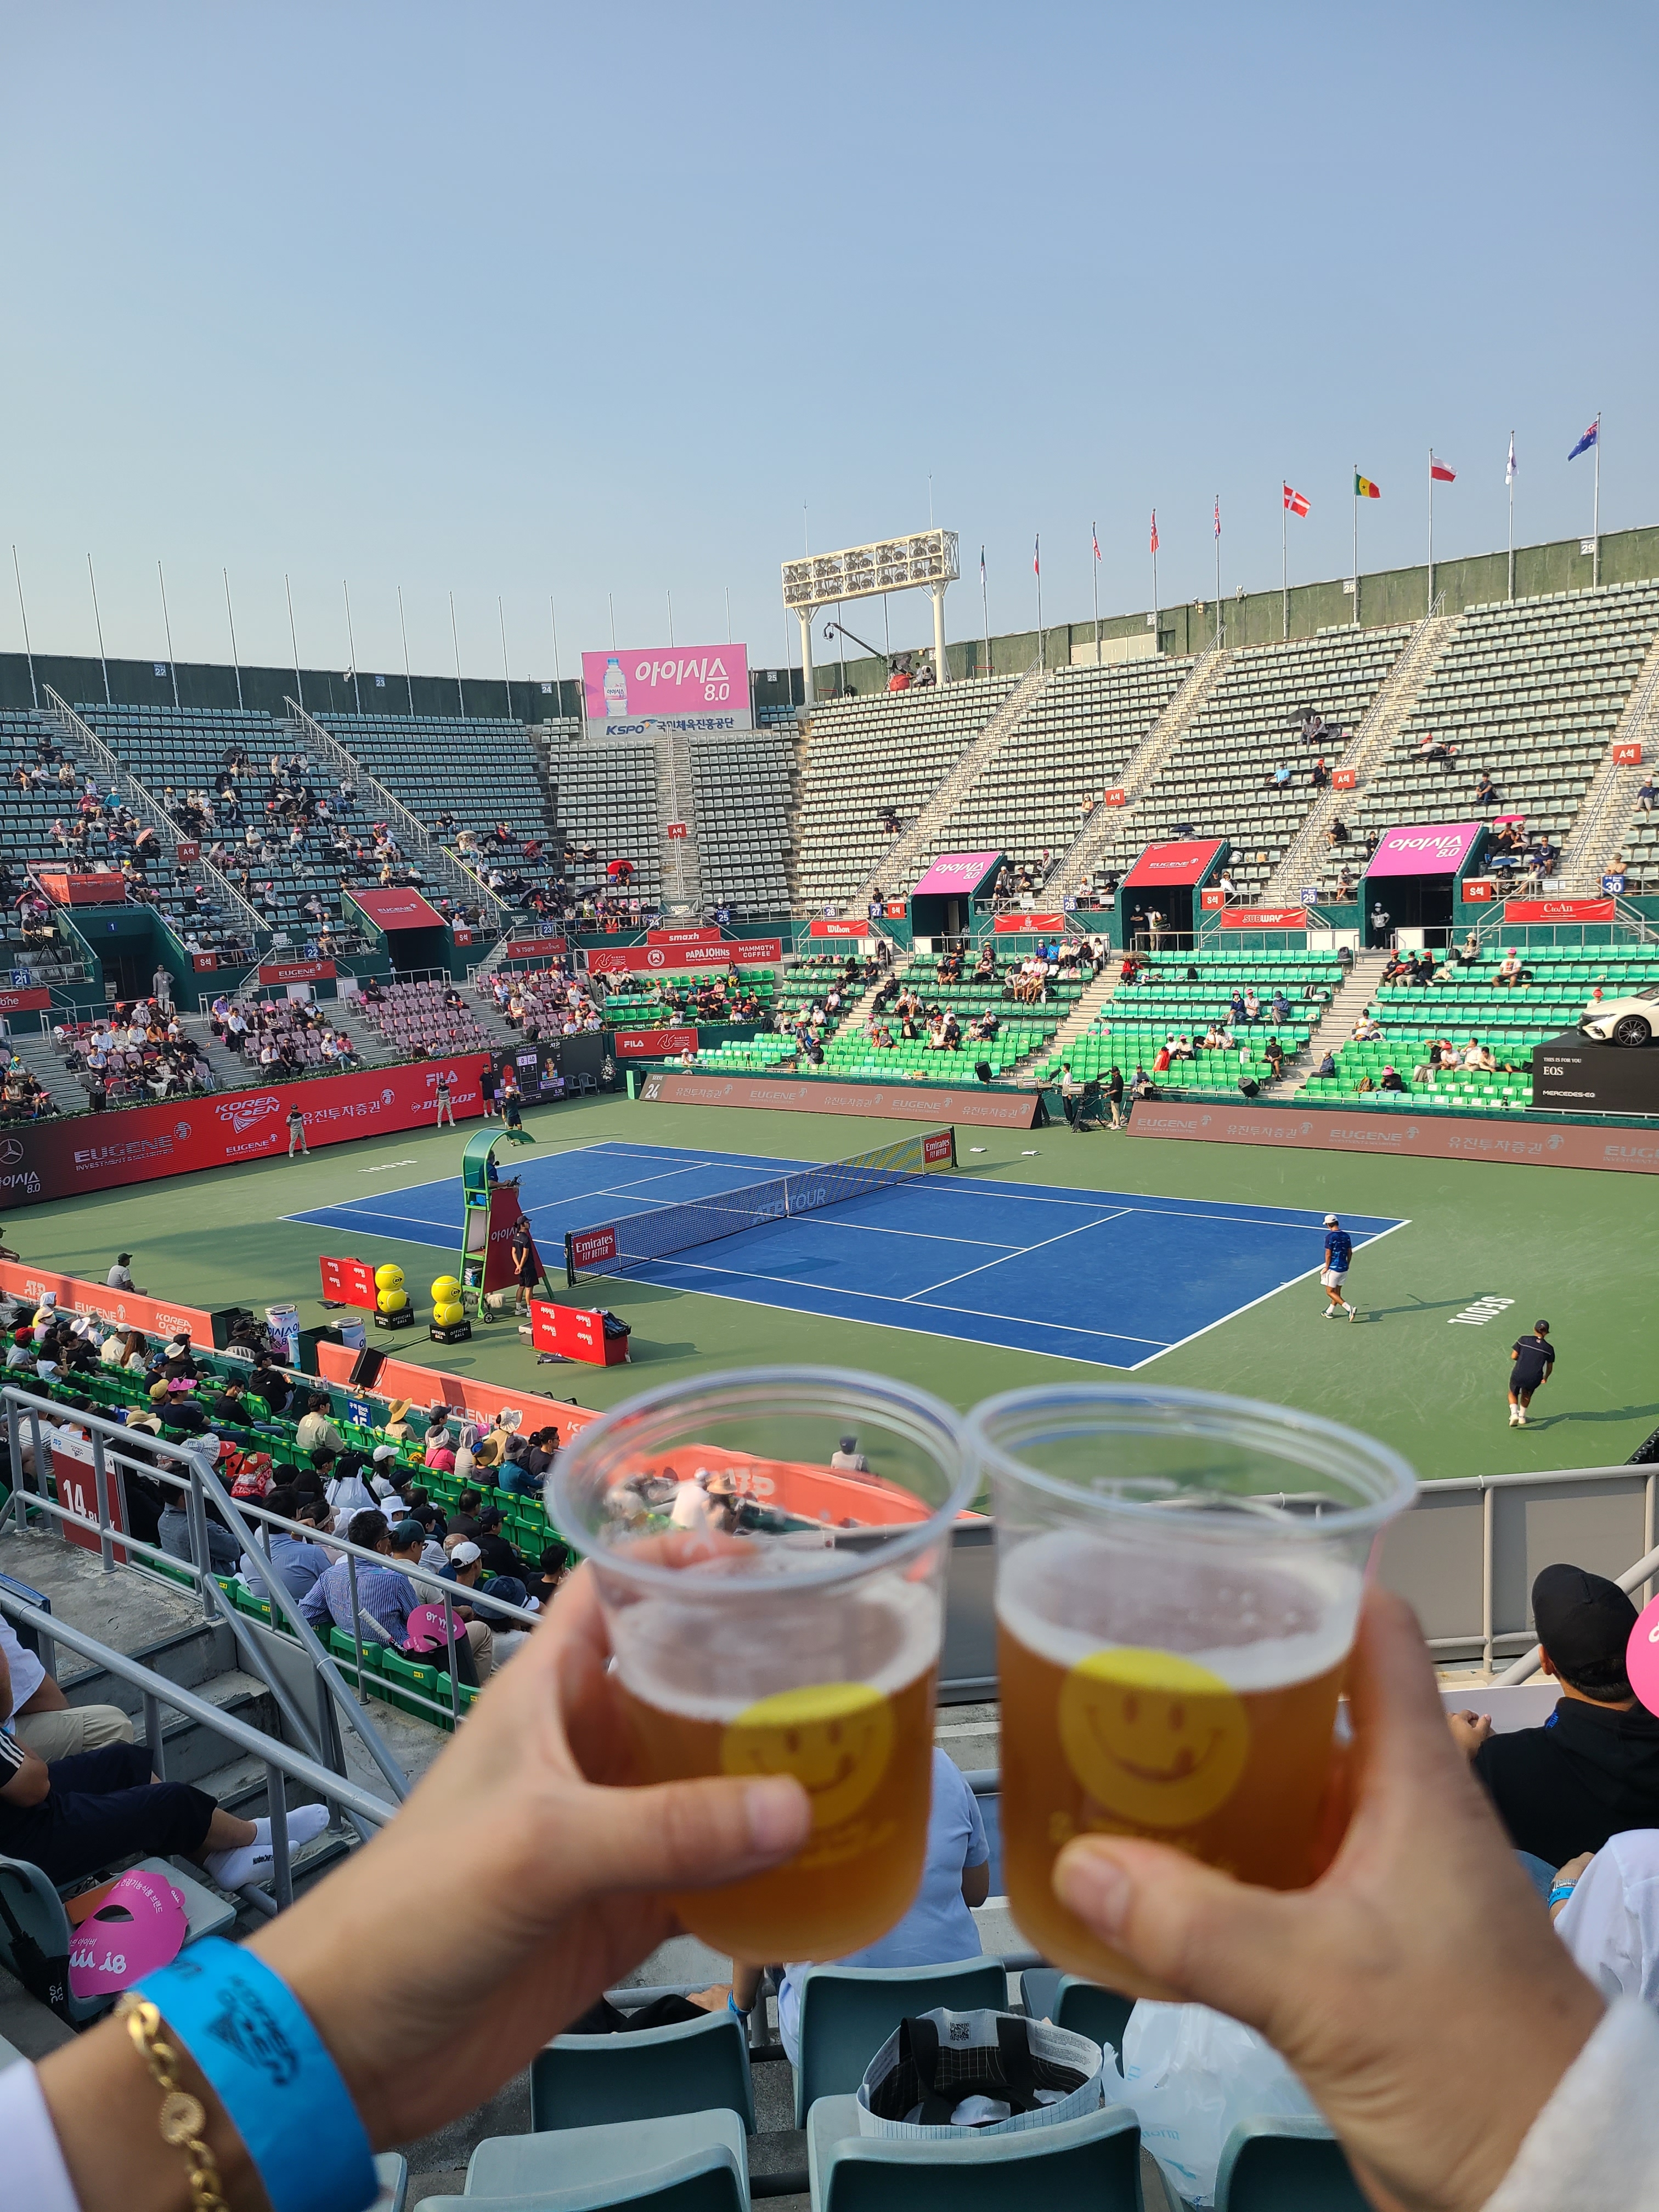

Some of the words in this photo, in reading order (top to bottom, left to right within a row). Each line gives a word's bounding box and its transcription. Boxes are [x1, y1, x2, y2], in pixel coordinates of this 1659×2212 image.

[1581, 543, 1594, 554] 29
[1344, 584, 1355, 593] 28
[155, 668, 166, 676] 22
[635, 658, 729, 686] 아이시스
[376, 679, 385, 687] 23
[704, 683, 730, 702] 8.0
[606, 724, 644, 736] KSPO
[1619, 748, 1635, 758] A석
[1338, 774, 1350, 783] A석
[1110, 792, 1120, 801] A석
[1389, 835, 1463, 851] 아이시스
[183, 847, 195, 855] A석
[1436, 847, 1460, 858] 8.0
[935, 861, 984, 874] 아이시스
[963, 871, 980, 879] 8.0
[1470, 886, 1484, 896] S석
[1606, 882, 1622, 892] 30
[1207, 895, 1218, 904] S석
[1303, 894, 1316, 903] 29
[1065, 901, 1075, 910] 28
[1544, 903, 1573, 912] CtoAn
[1242, 914, 1283, 923] SUBWAY
[544, 926, 552, 934] 23
[827, 924, 850, 933] Wilson
[459, 933, 469, 941] S석
[669, 932, 699, 941] smaxh
[308, 949, 319, 957] 22
[686, 949, 705, 958] PAPA
[705, 948, 730, 957] JOHNS
[200, 957, 212, 966] S석
[278, 968, 316, 977] EUGENE
[15, 974, 27, 985] 21
[624, 1040, 644, 1048] FILA
[1543, 1066, 1564, 1076] EQS
[426, 1070, 458, 1087] FILA
[645, 1083, 661, 1099] 24
[676, 1087, 722, 1099] 유진투자증권
[751, 1090, 797, 1100] EUGENE
[215, 1096, 280, 1114] KOREA
[422, 1092, 476, 1110] DULOP
[824, 1096, 872, 1108] 유진투자증권
[892, 1099, 941, 1110] EUGENE
[302, 1101, 381, 1125] 유진투자증권
[962, 1105, 1018, 1119] 유진투자증권
[1137, 1118, 1198, 1129] EUGENE
[1226, 1124, 1297, 1139] 유진투자증권
[1330, 1129, 1402, 1142] EUGENE
[74, 1135, 173, 1164] EUGENE
[226, 1139, 269, 1153] EUGENE
[925, 1138, 950, 1153] Emirates
[1447, 1136, 1543, 1155] 유진투자증권
[935, 1147, 946, 1158] BETTER
[1605, 1145, 1659, 1160] EUG
[357, 1159, 417, 1173] SEOUL
[27, 1183, 41, 1194] 8.0
[788, 1188, 826, 1210] TOUR
[492, 1226, 518, 1242] 아이시
[576, 1235, 613, 1254] Emirates
[591, 1246, 608, 1259] BETTER
[24, 1280, 46, 1296] ATP
[1447, 1296, 1515, 1325] SEOUL
[155, 1312, 193, 1328] KOREA
[392, 1313, 411, 1322] OFFICIAL
[450, 1327, 469, 1336] OFFICIAL
[349, 1402, 357, 1410] 구역
[358, 1404, 369, 1413] Block
[353, 1415, 368, 1427] 15
[88, 1510, 115, 1531] BLK
[120, 1878, 154, 1898] 건강기능식품
[150, 1894, 163, 1914] 브랜드
